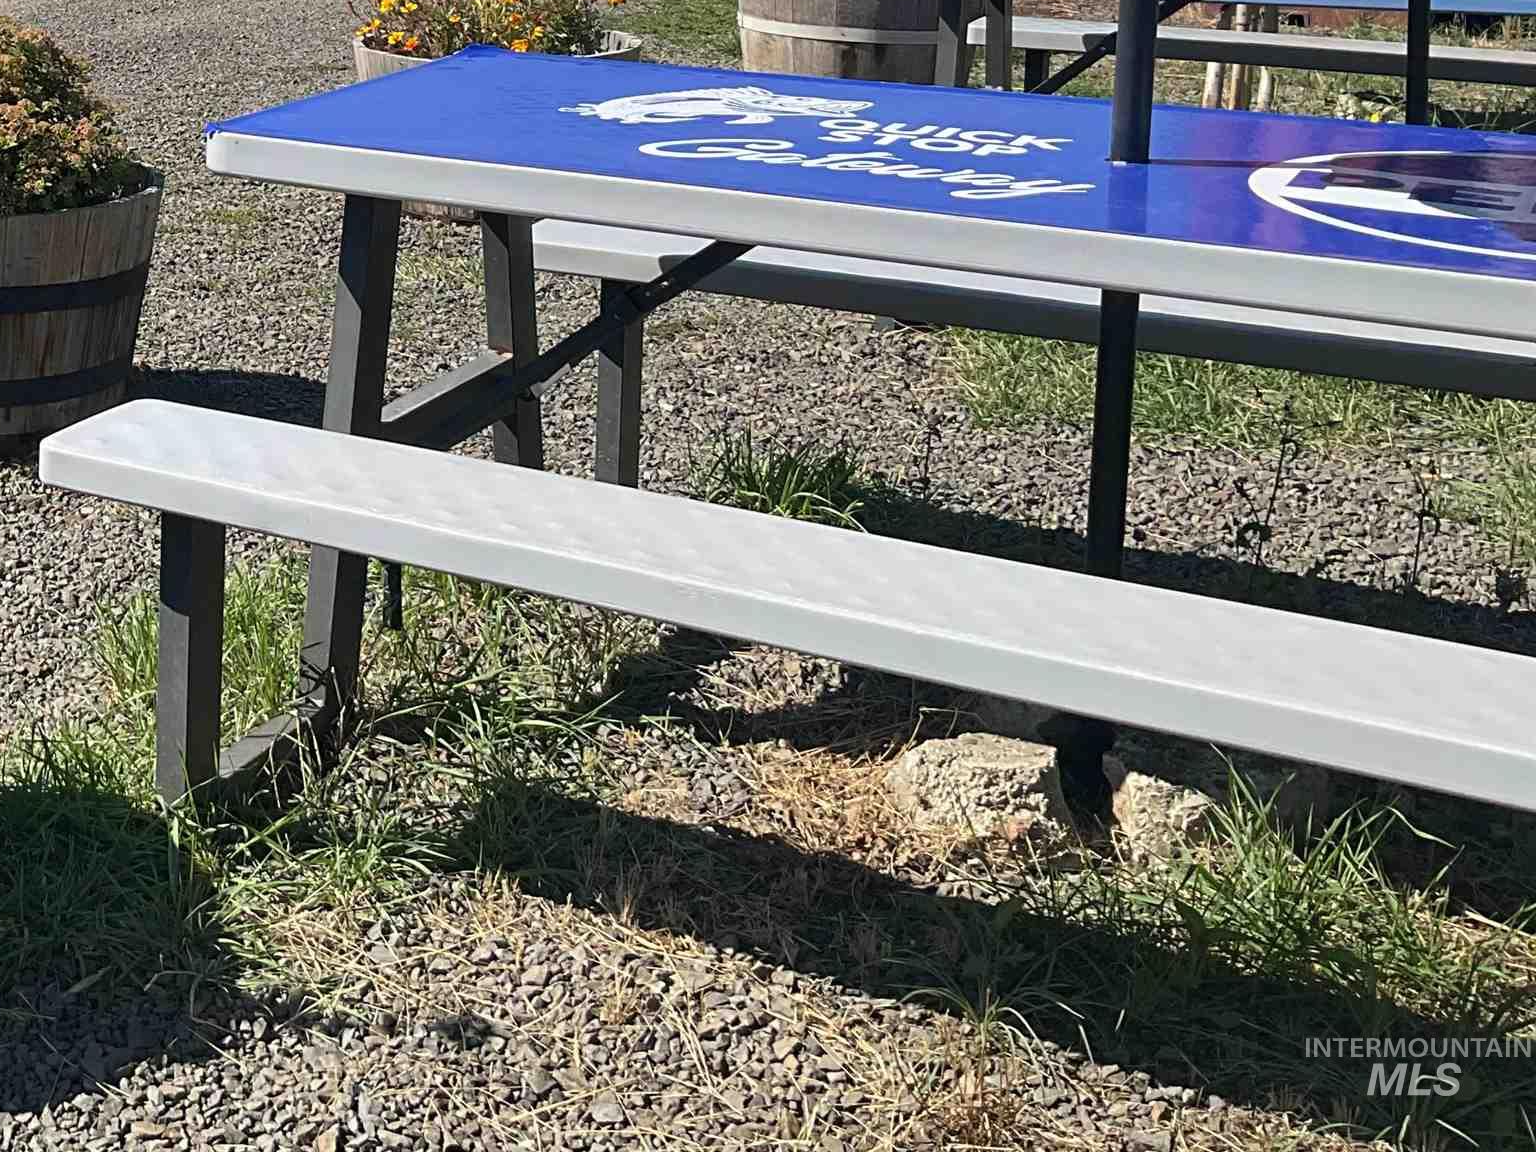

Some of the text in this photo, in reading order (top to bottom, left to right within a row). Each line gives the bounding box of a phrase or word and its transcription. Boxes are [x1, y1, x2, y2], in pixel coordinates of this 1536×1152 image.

[817, 130, 1029, 157] STOP
[819, 119, 1073, 151] QUICK
[637, 138, 1096, 200] Gateway
